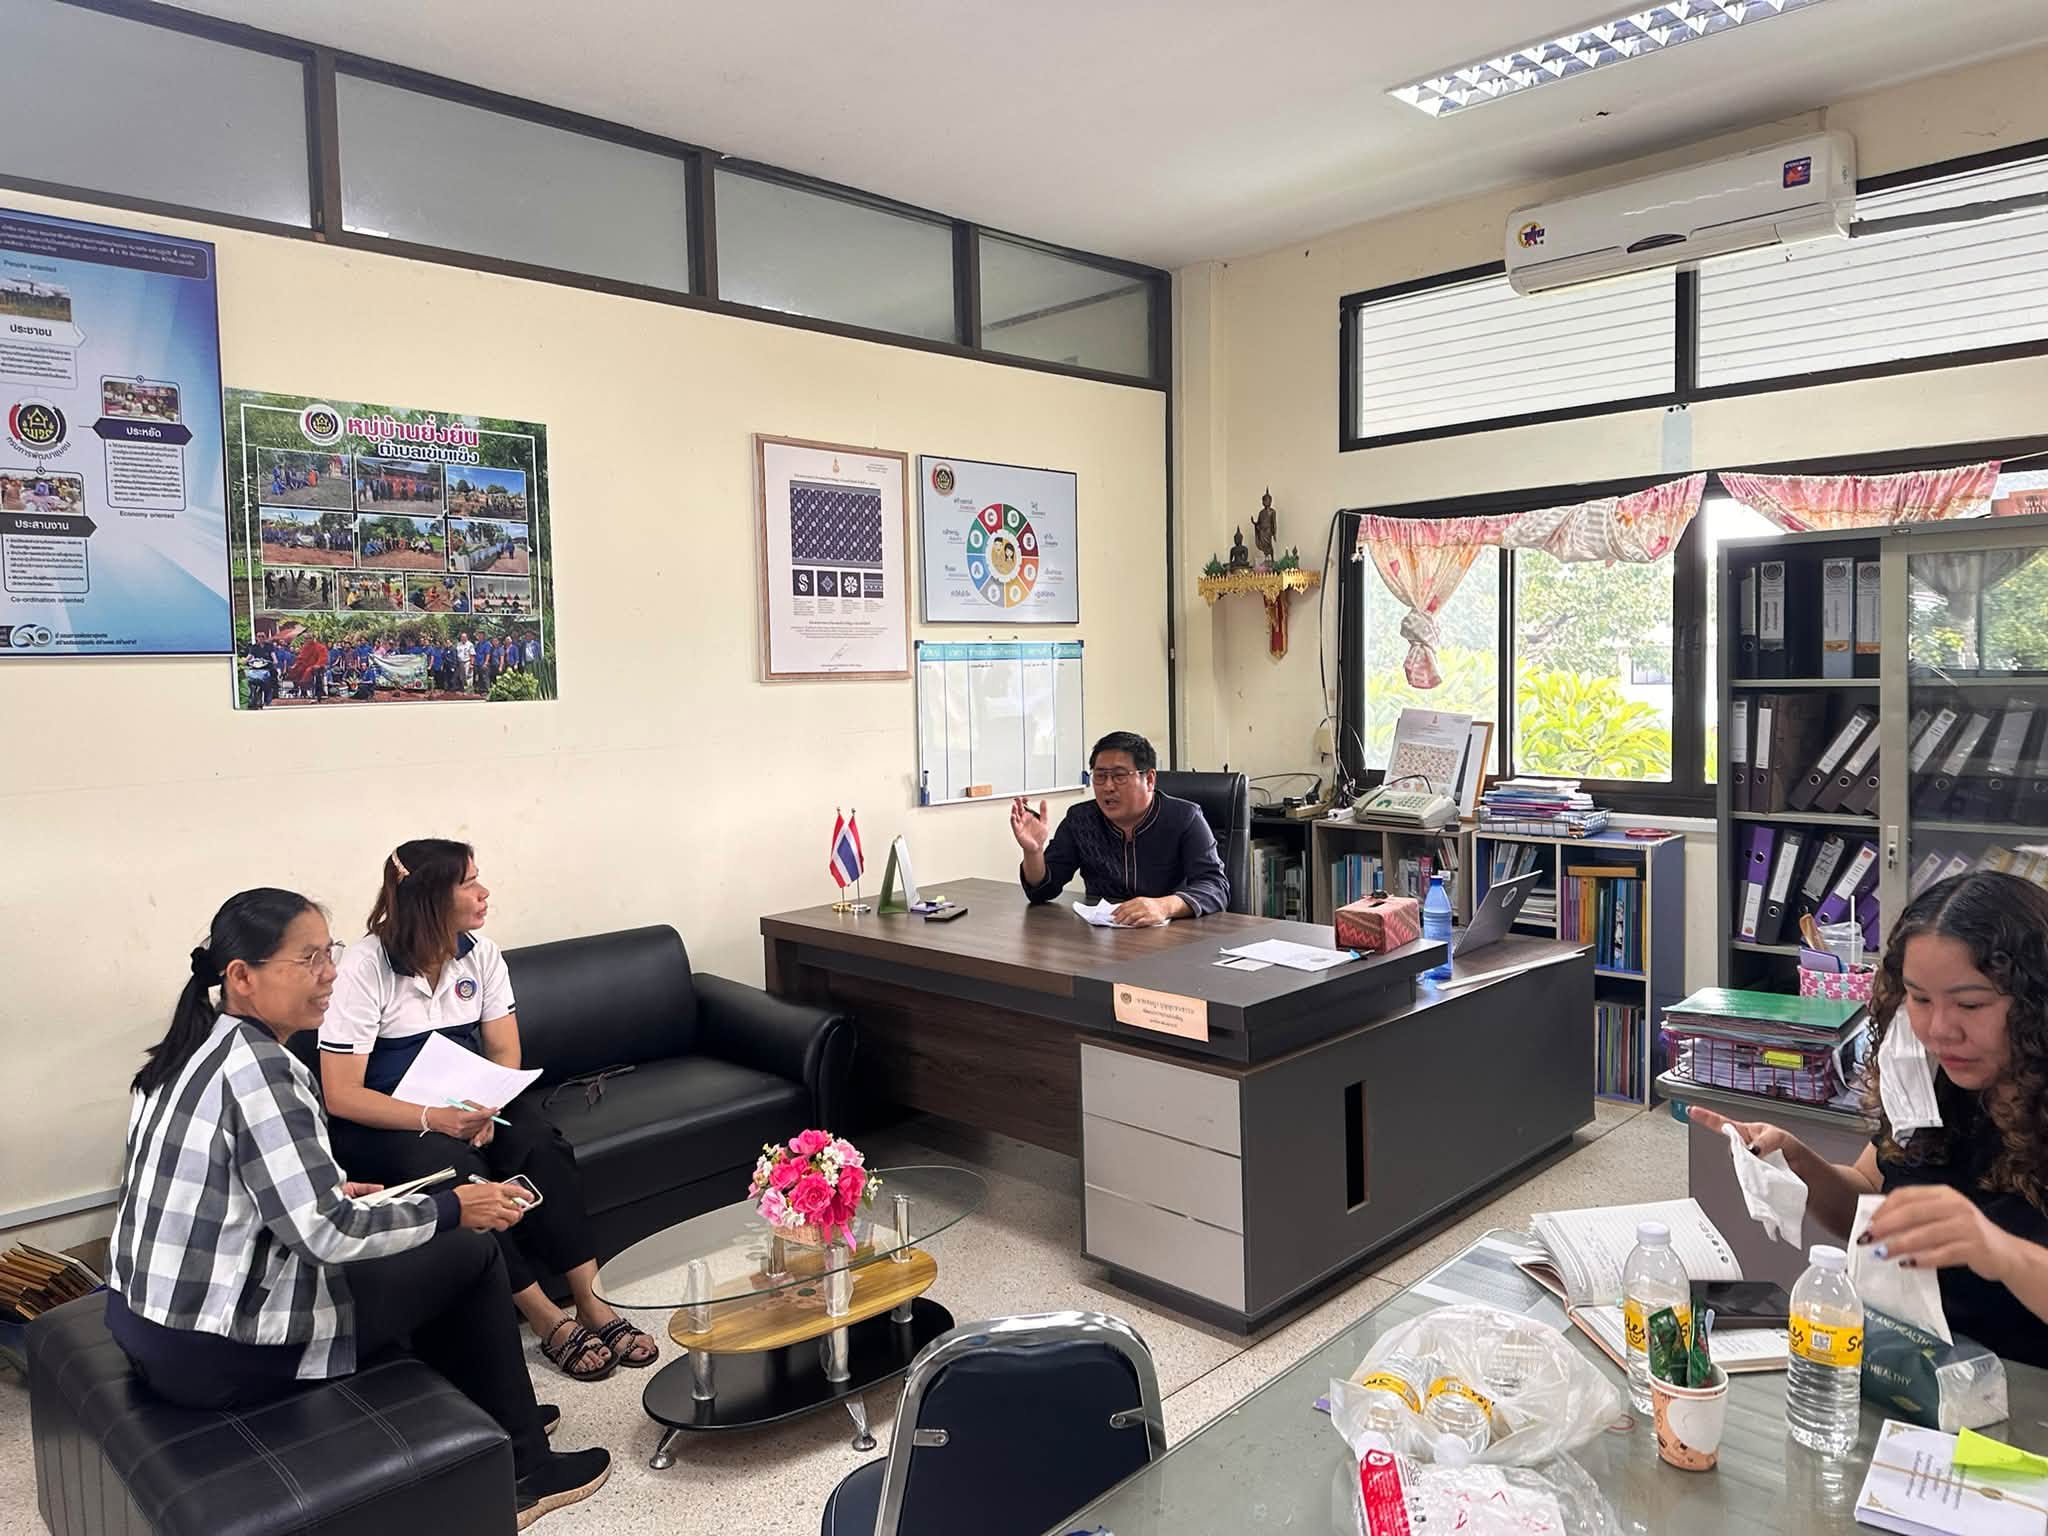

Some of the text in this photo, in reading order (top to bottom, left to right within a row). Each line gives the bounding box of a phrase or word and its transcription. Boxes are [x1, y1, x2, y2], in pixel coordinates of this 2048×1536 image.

[9, 323, 53, 337] ประชาชน
[126, 426, 162, 438] ประหยัด
[347, 414, 478, 446] หมู่บ้านยั่งยืน
[378, 442, 479, 463] ตำบลเข้มแข็ง
[15, 519, 69, 530] ประสานงาน
[1870, 1363, 1913, 1387] HEALTHY
